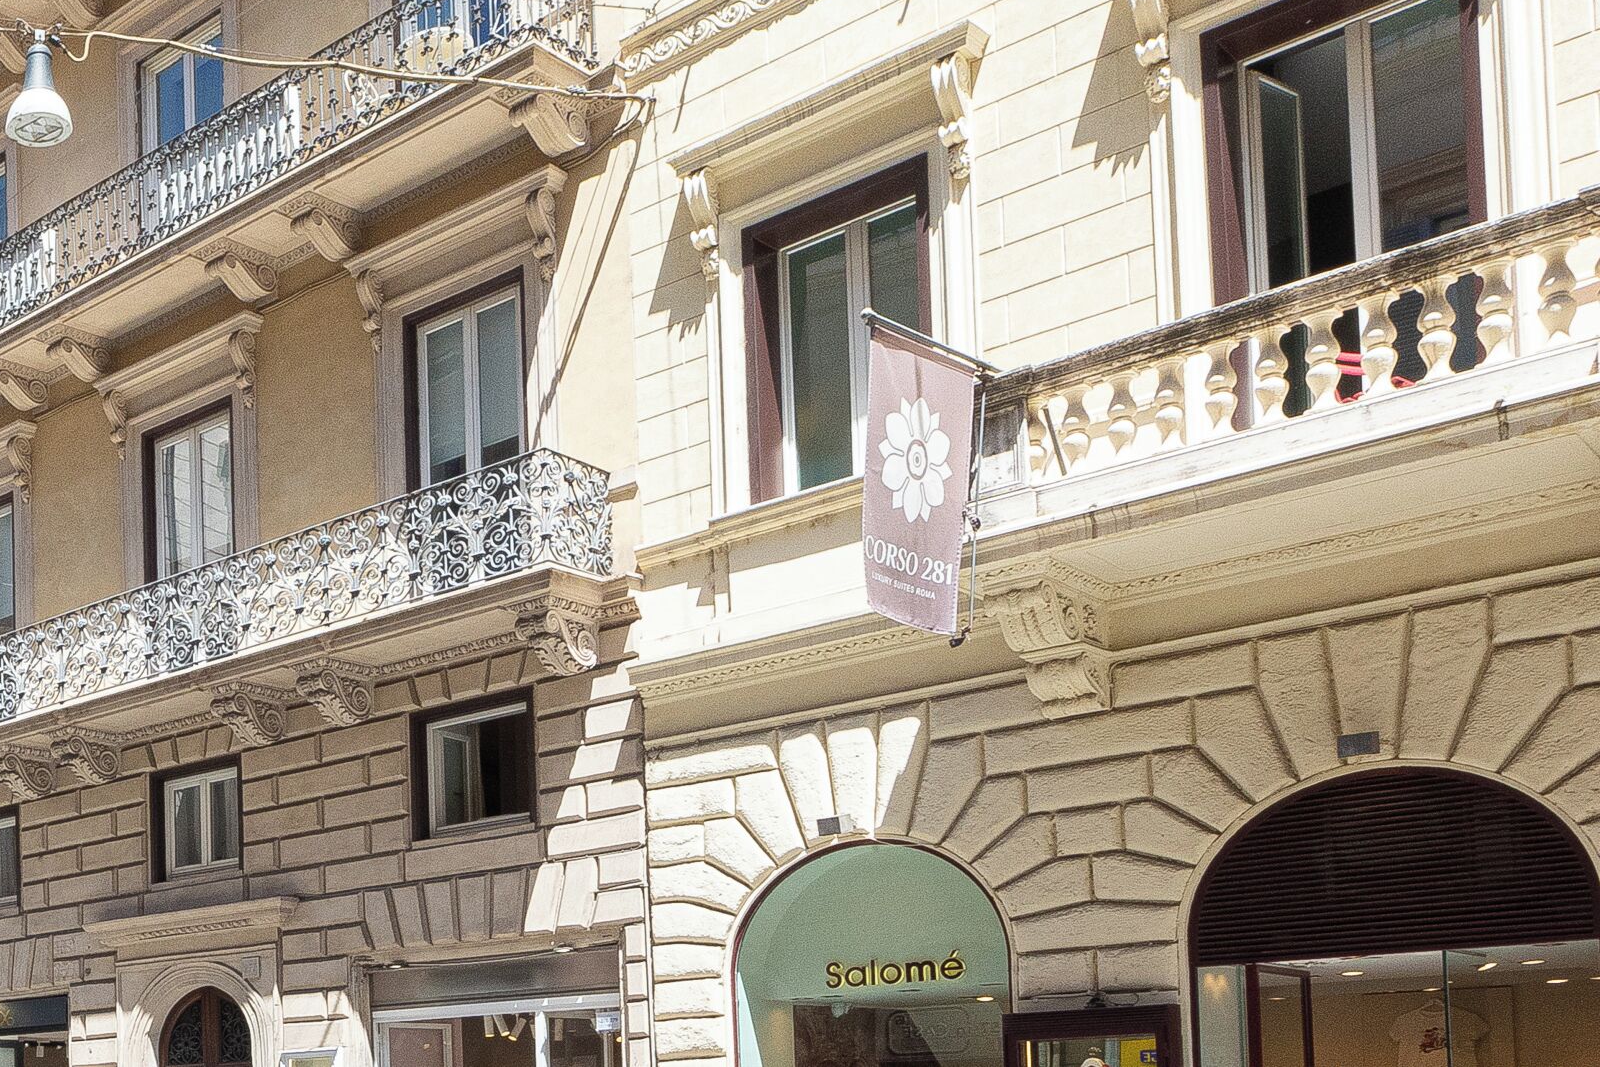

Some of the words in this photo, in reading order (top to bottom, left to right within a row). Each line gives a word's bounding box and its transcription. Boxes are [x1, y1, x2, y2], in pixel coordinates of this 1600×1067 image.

[865, 534, 919, 576] CORSO
[920, 556, 954, 585] 281
[871, 571, 894, 586] LUXURY
[893, 579, 915, 594] SUITES
[915, 586, 936, 600] ROMA
[825, 949, 967, 989] Salomé
